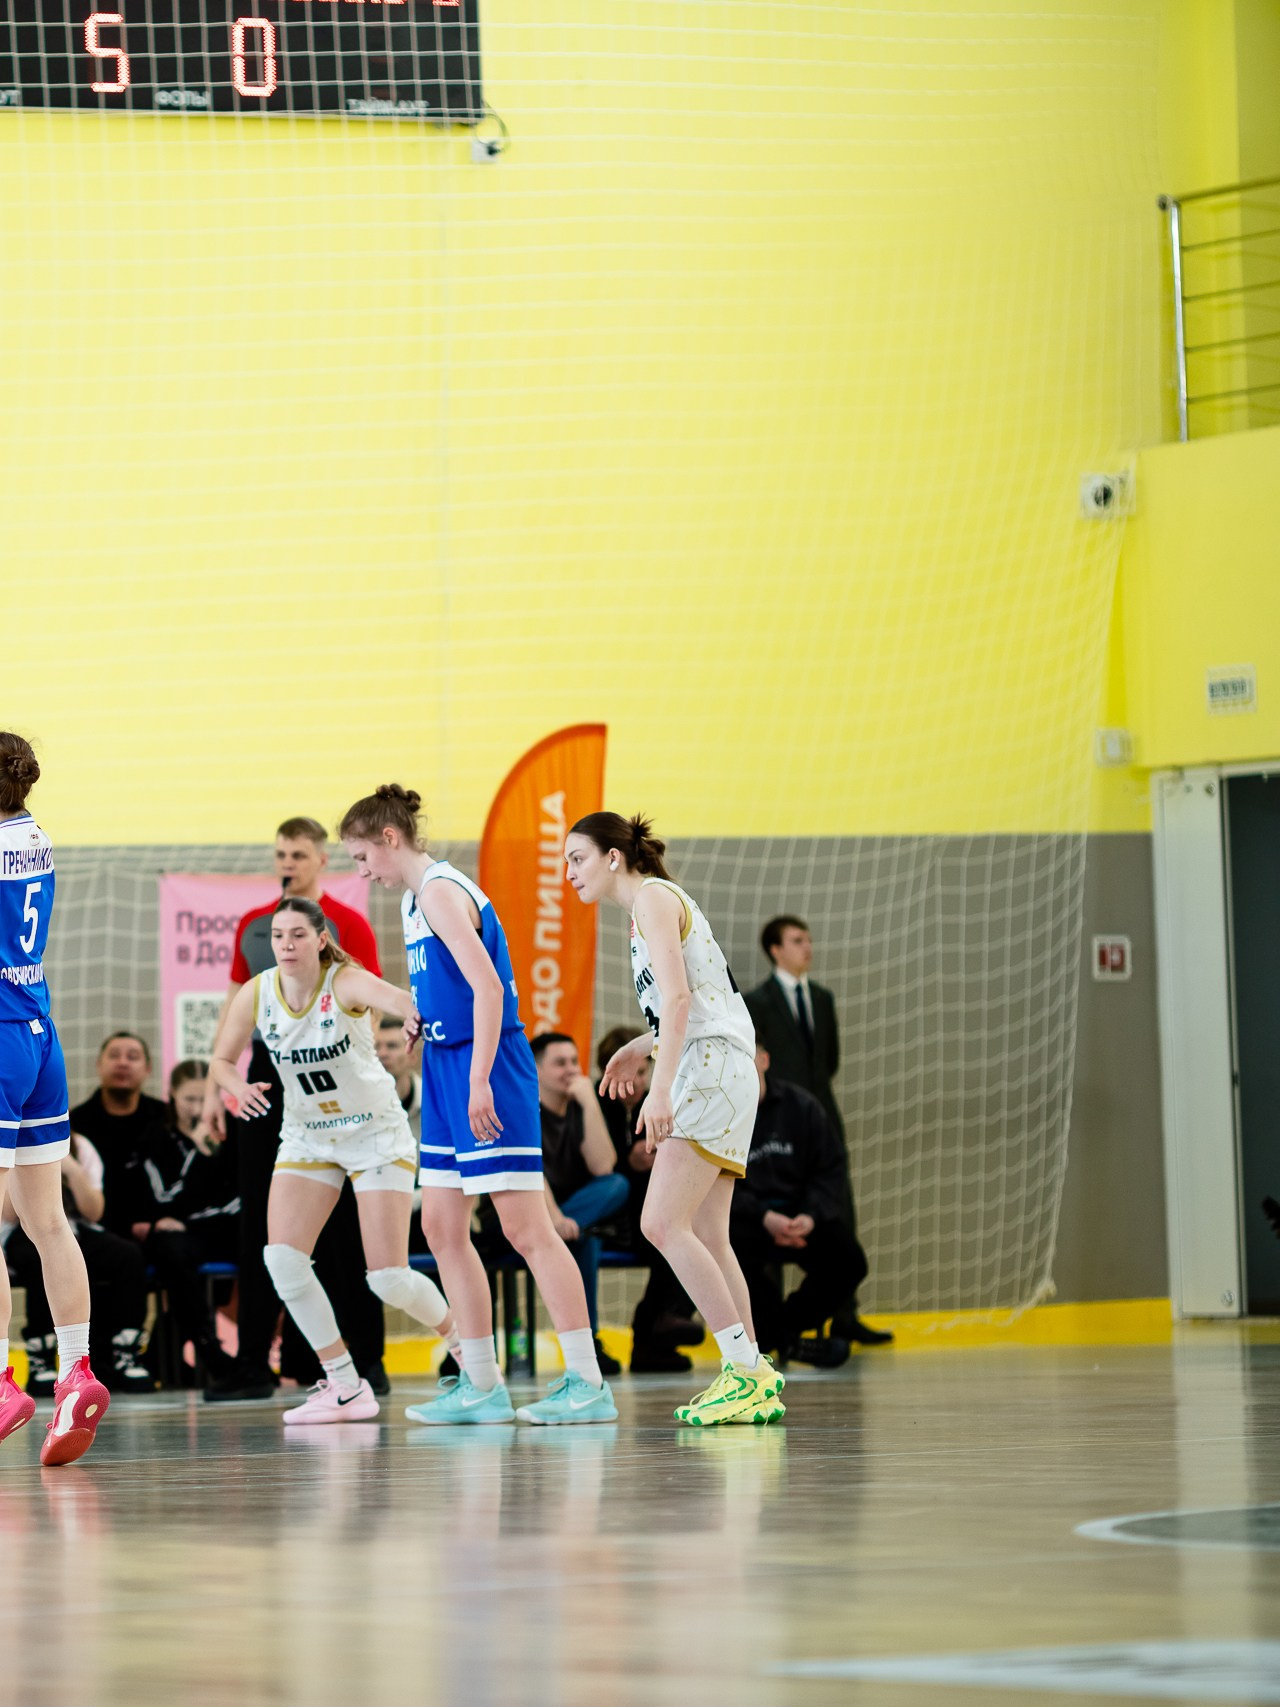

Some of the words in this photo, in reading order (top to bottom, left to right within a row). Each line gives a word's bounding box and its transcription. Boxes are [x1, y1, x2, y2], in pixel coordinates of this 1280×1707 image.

[85, 13, 129, 93] 5
[232, 17, 276, 97] 0
[534, 790, 567, 951] ПИЦЦА
[19, 881, 42, 954] 5
[177, 912, 242, 936] Прос
[296, 1070, 337, 1096] 10
[304, 1112, 373, 1130] ХИМПРОМ
